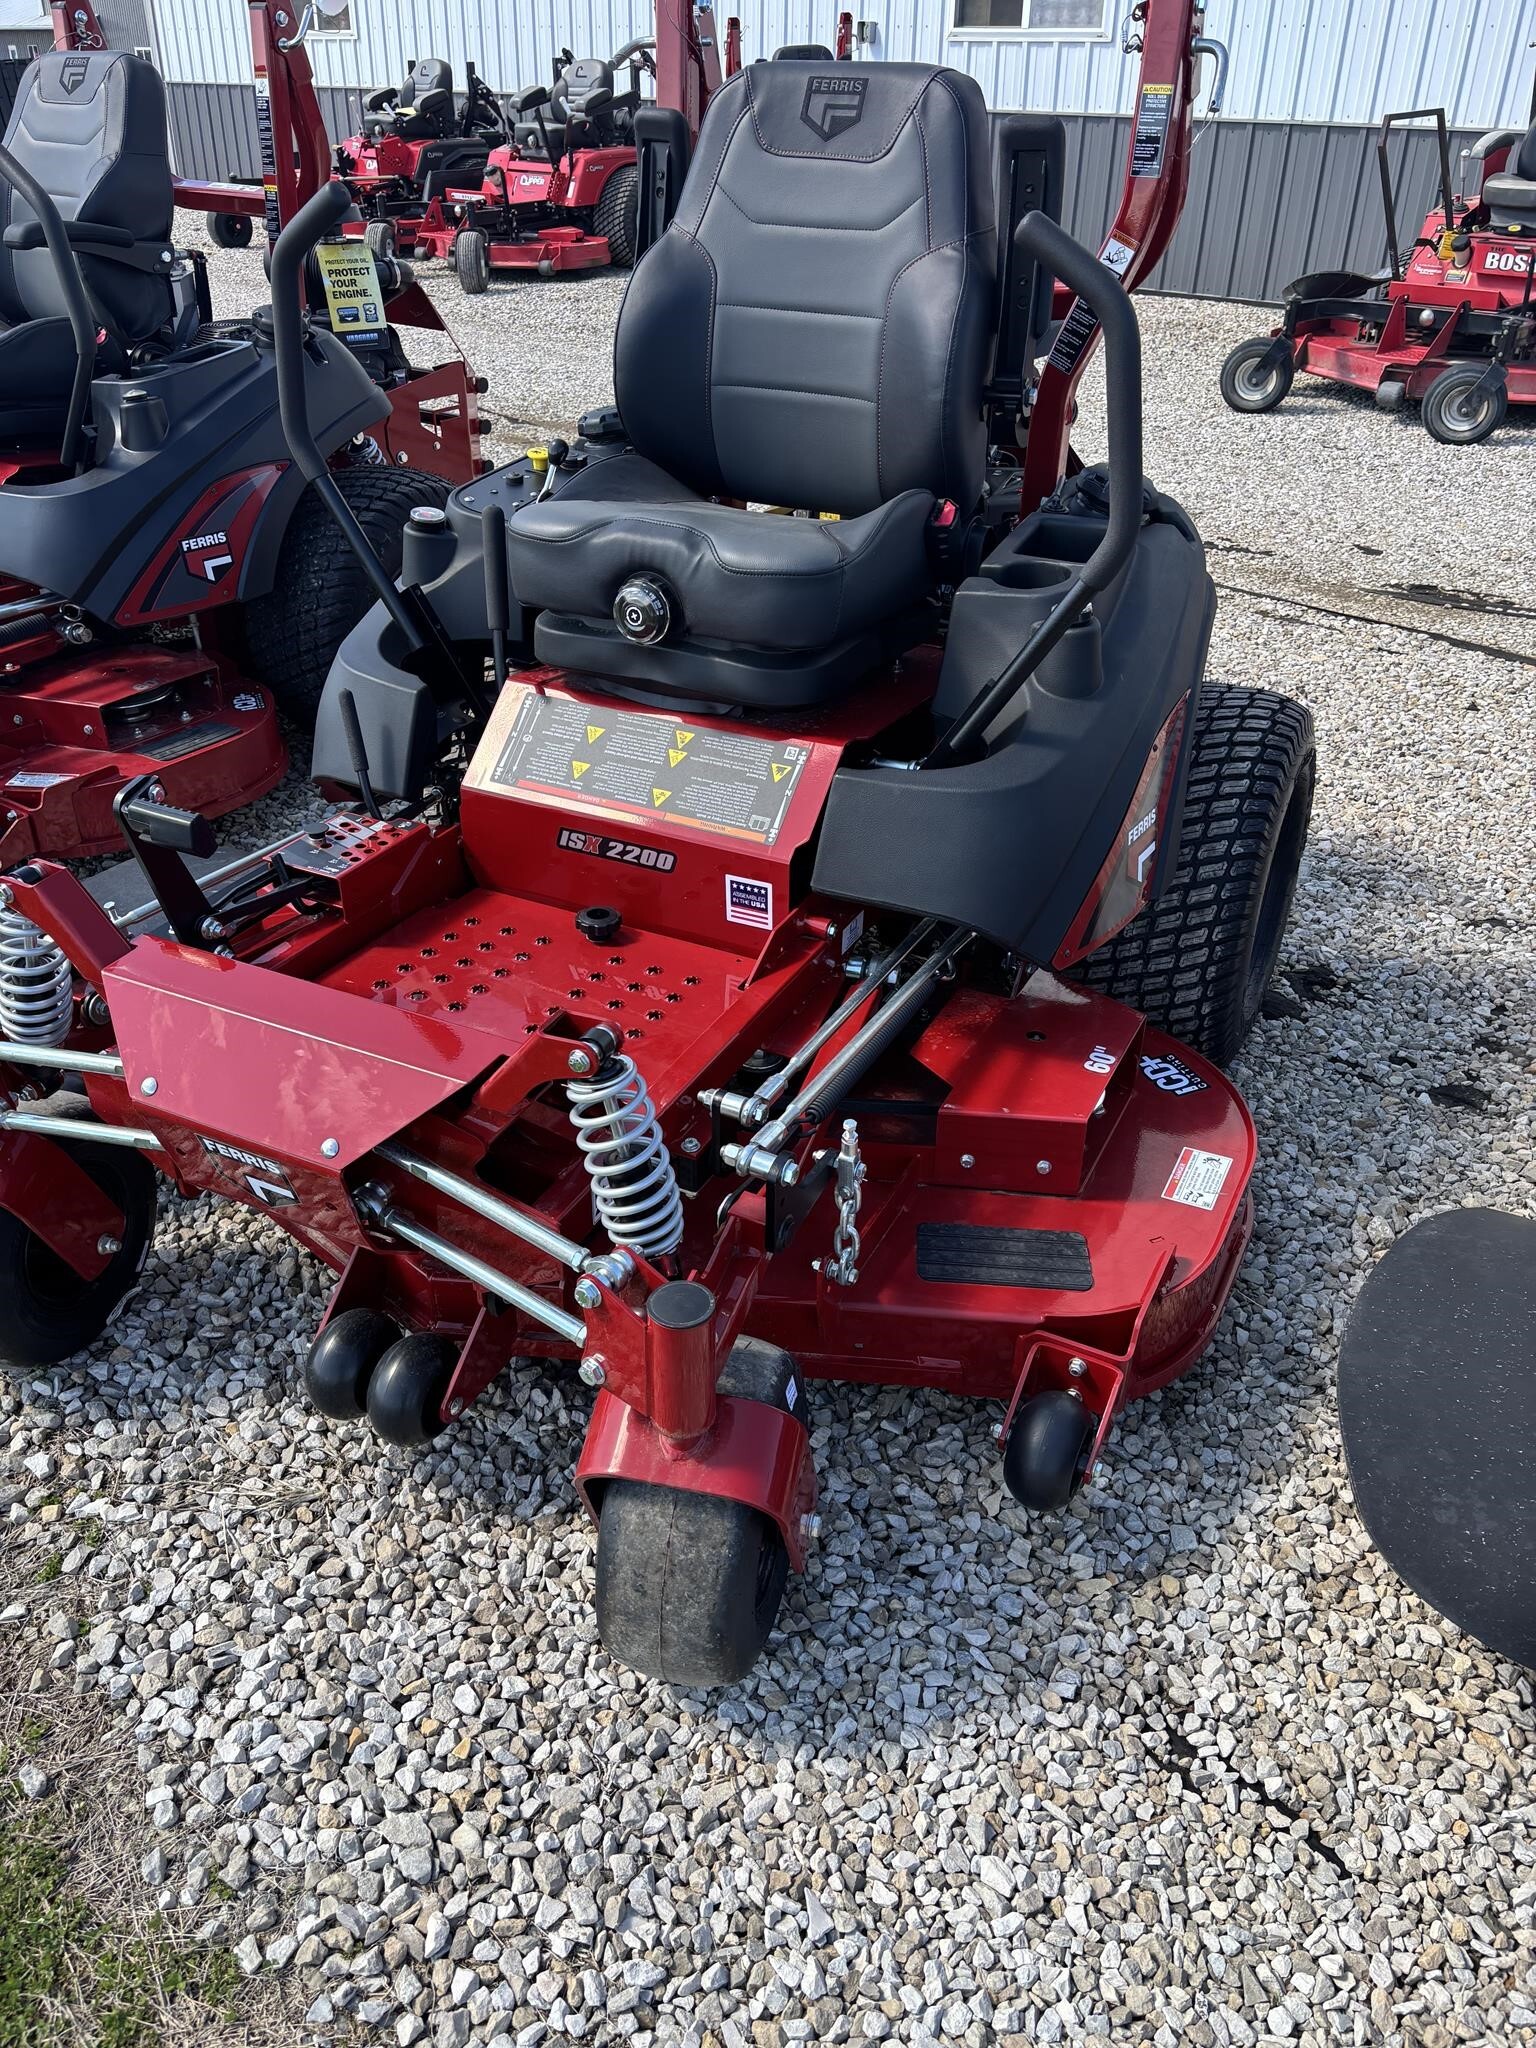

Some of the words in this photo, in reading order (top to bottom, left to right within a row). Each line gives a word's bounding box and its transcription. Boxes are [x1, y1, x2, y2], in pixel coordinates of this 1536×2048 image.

[66, 58, 87, 66] FERRIS
[812, 79, 863, 92] FERRIS
[327, 267, 370, 277] PROTECT
[330, 279, 357, 288] YOUR
[332, 289, 372, 299] ENGINE.
[364, 305, 375, 314] 3
[181, 531, 227, 551] FERRIS
[1127, 807, 1156, 847] FERRIS
[559, 830, 602, 855] ISX
[605, 841, 675, 870] 2200
[732, 891, 766, 903] ASSEMBLED
[751, 901, 766, 909] USA
[1083, 1045, 1116, 1074] 60"
[1166, 1054, 1208, 1089] CUTTING
[202, 1138, 281, 1175] FERRIS
